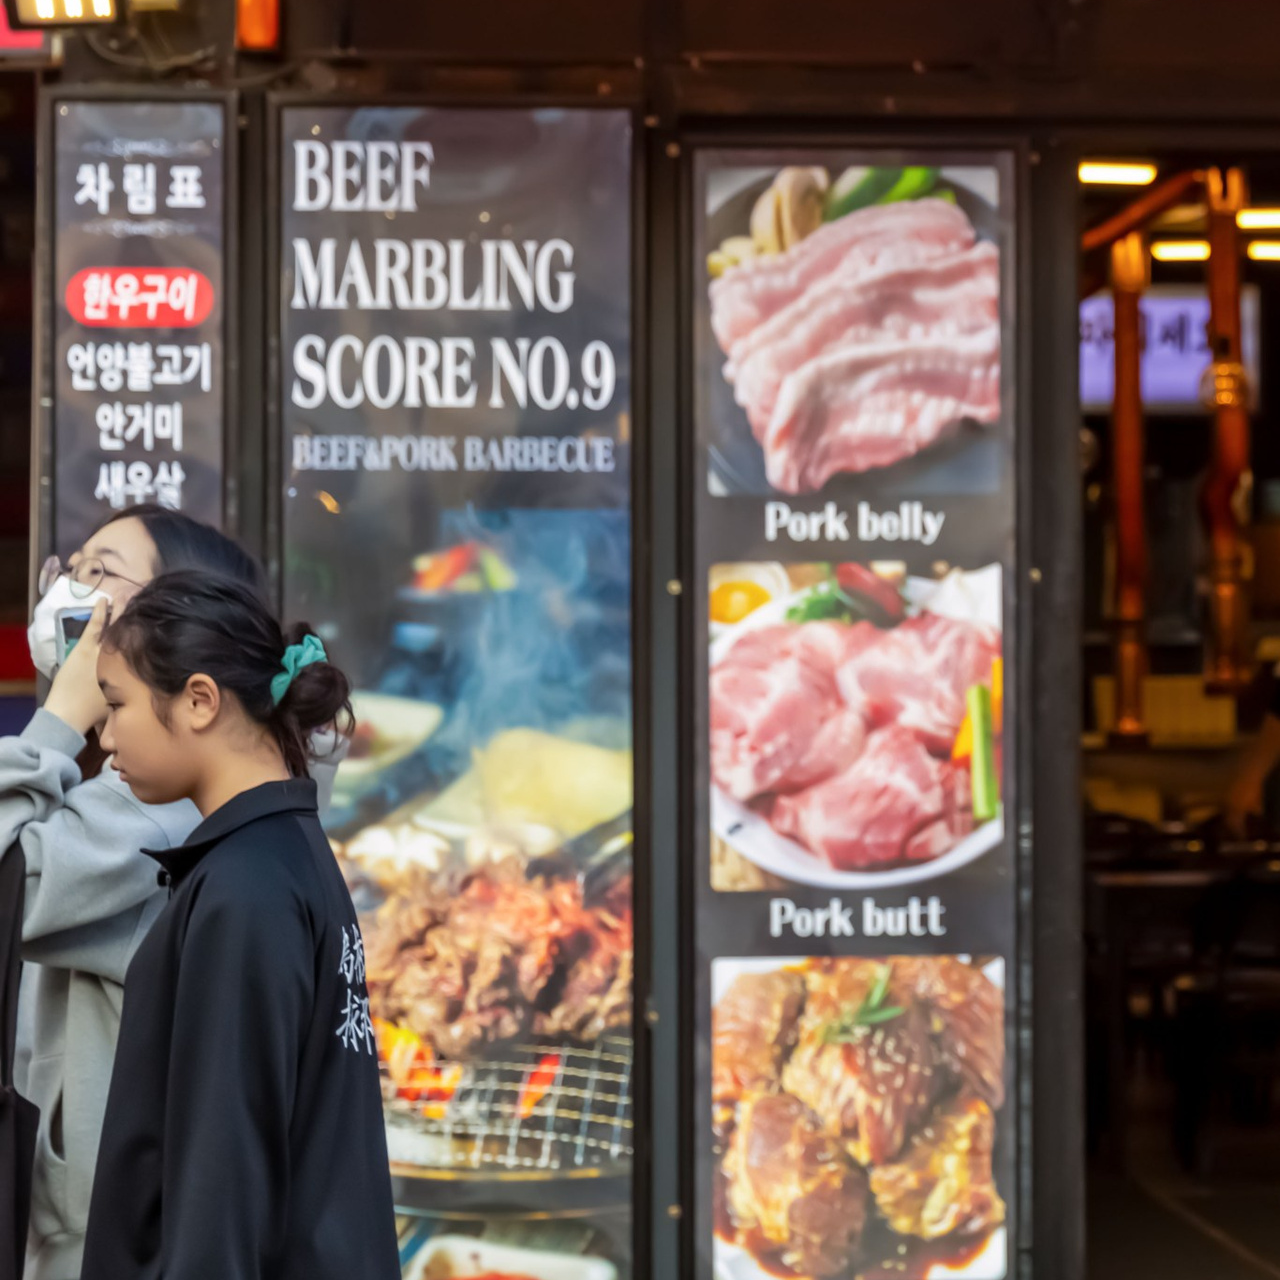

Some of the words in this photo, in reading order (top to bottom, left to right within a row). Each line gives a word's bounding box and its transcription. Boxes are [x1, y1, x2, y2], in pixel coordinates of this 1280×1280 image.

[293, 139, 435, 212] BEEF
[83, 273, 199, 321] 한우구이
[291, 237, 576, 314] MARBLING
[67, 341, 212, 392] 언양불고기
[291, 334, 477, 410] SCORE
[489, 337, 617, 412] NO.9
[95, 401, 182, 452] 안거미
[293, 434, 457, 472] BEEF&PORK
[464, 435, 616, 473] BARBECUE
[94, 460, 185, 510] 새우살
[764, 501, 849, 543] Pork
[857, 500, 946, 546] belly
[769, 897, 854, 939] Pork
[862, 896, 948, 939] butt
